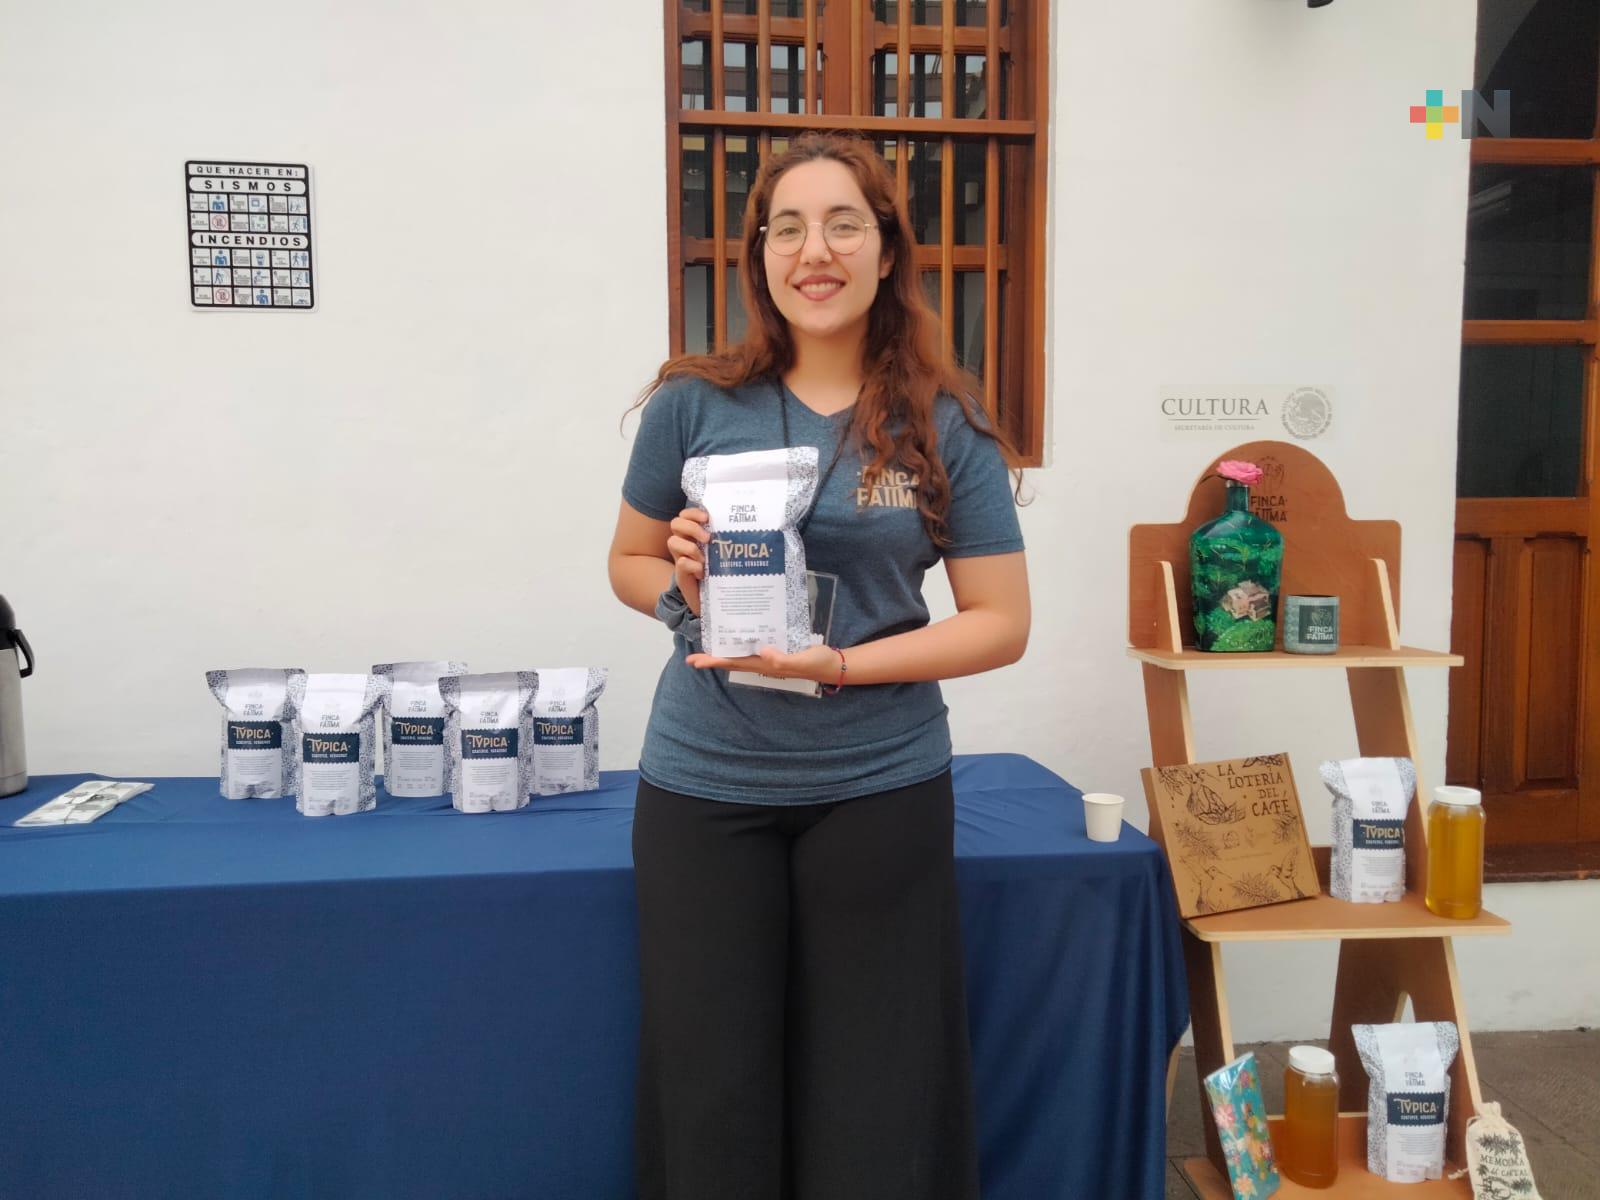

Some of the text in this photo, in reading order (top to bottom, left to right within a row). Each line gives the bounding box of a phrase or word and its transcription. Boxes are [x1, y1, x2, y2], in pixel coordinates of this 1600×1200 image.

[229, 167, 271, 176] HACER
[205, 180, 291, 192] SISMOS
[200, 234, 301, 246] INCENDIOS
[1161, 398, 1269, 415] CULTURA
[857, 485, 917, 509] FATIM
[1251, 496, 1286, 506] FINCA
[730, 504, 757, 513] FINCA
[712, 540, 769, 559] TYPICA
[231, 726, 272, 739] TYPICA
[395, 721, 434, 735] TYPICA
[536, 722, 574, 735] TYPICA
[307, 738, 348, 752] TYPICA
[466, 734, 508, 748] TYPICA
[1217, 764, 1236, 777] LA
[1257, 788, 1279, 799] DEL
[1252, 791, 1291, 816] CAFÉ
[1360, 824, 1401, 839] TYPICA
[1393, 1099, 1437, 1114] TYPICA
